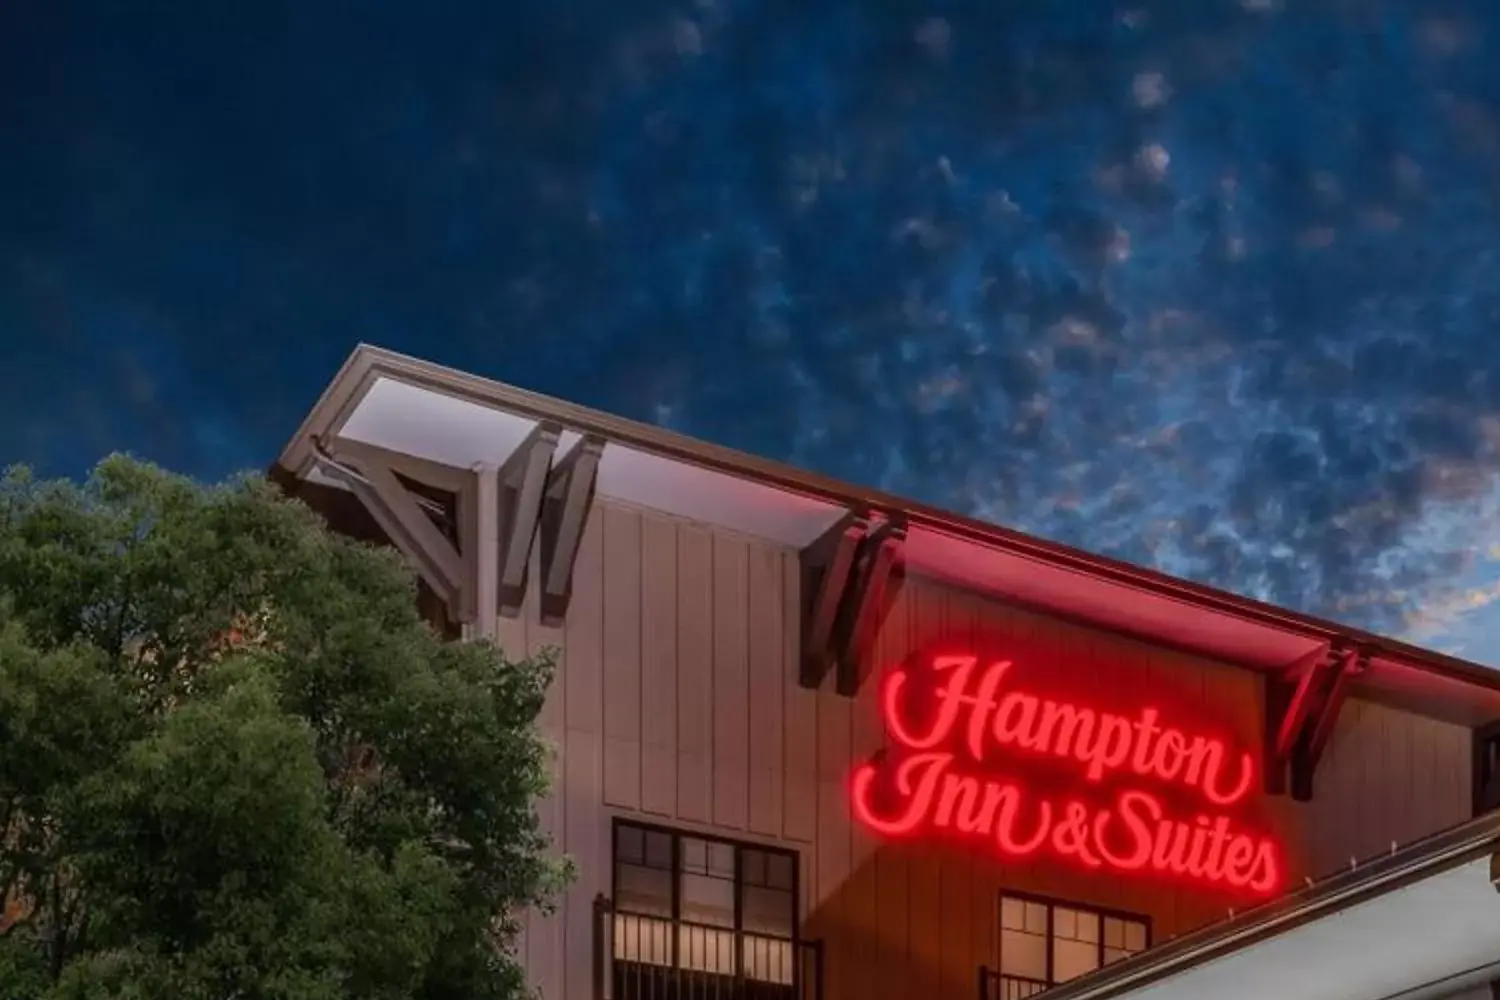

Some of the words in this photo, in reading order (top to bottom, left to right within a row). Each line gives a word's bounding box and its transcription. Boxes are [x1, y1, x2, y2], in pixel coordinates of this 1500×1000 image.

[886, 655, 1252, 804] Hampton
[855, 752, 1050, 854] Inn
[1052, 802, 1101, 865] &
[1098, 792, 1278, 891] Suites
